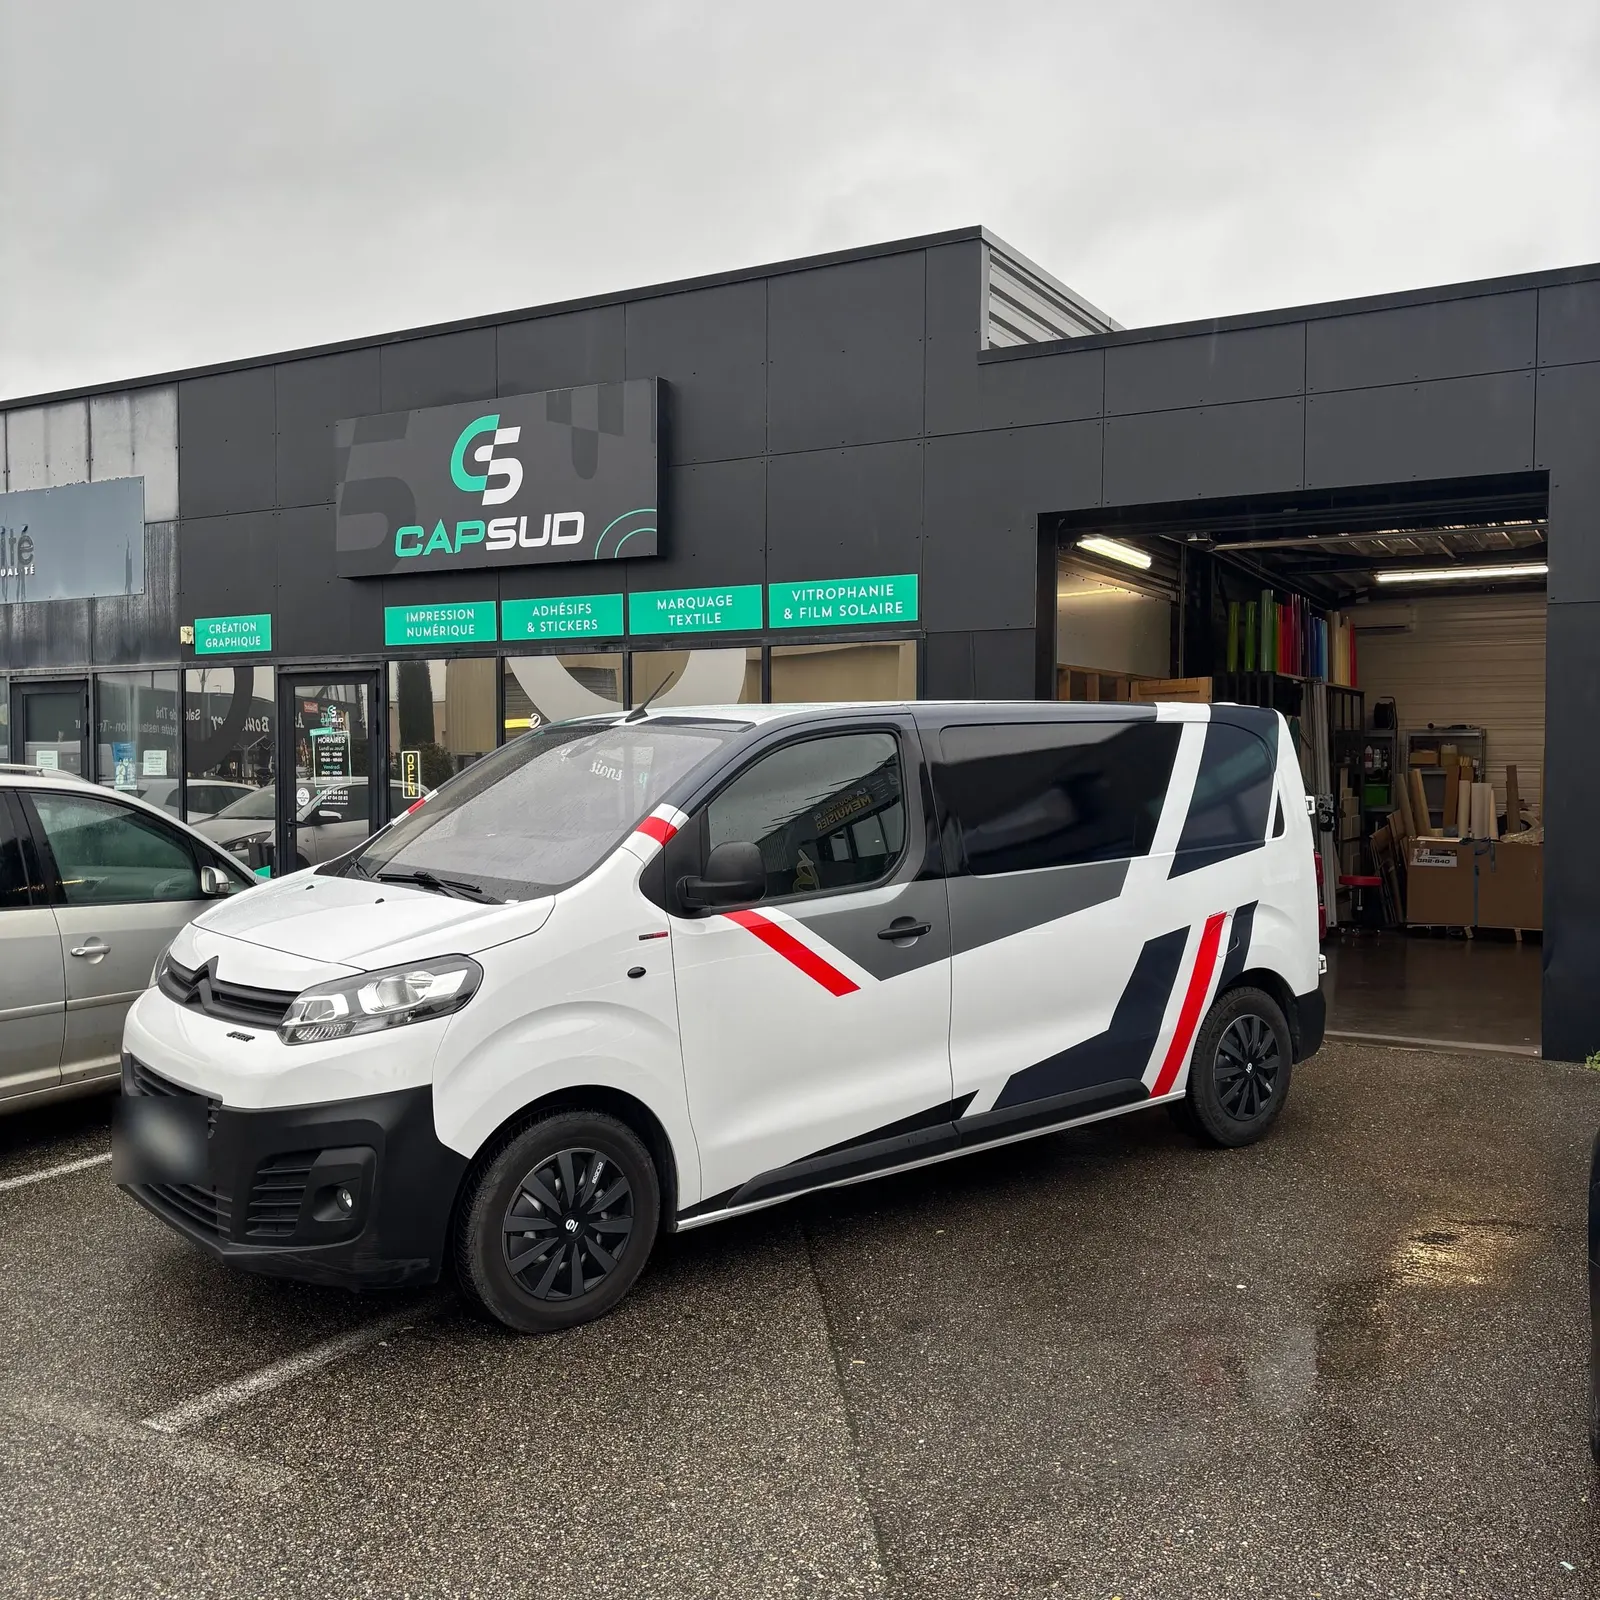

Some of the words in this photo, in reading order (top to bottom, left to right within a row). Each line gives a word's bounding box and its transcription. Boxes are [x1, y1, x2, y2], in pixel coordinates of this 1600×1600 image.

[394, 511, 586, 558] CAPSUD
[791, 584, 895, 602] VITROPHANIE
[657, 595, 733, 610] MARQUAGE
[406, 609, 475, 622] IMPRESSION
[532, 603, 592, 617] ADHÉSIFS
[783, 608, 793, 620] &
[800, 606, 833, 619] FILM
[839, 601, 904, 617] SOLAIRE
[526, 622, 535, 633] &
[540, 619, 598, 633] STICKERS
[668, 612, 722, 627] TEXTILE
[208, 621, 257, 634] CRÉATION
[406, 624, 475, 638] NUMÉRIQUE
[205, 635, 261, 648] GRAPHIQUE
[317, 736, 346, 744] HORAIRES
[407, 754, 416, 796] OPEN
